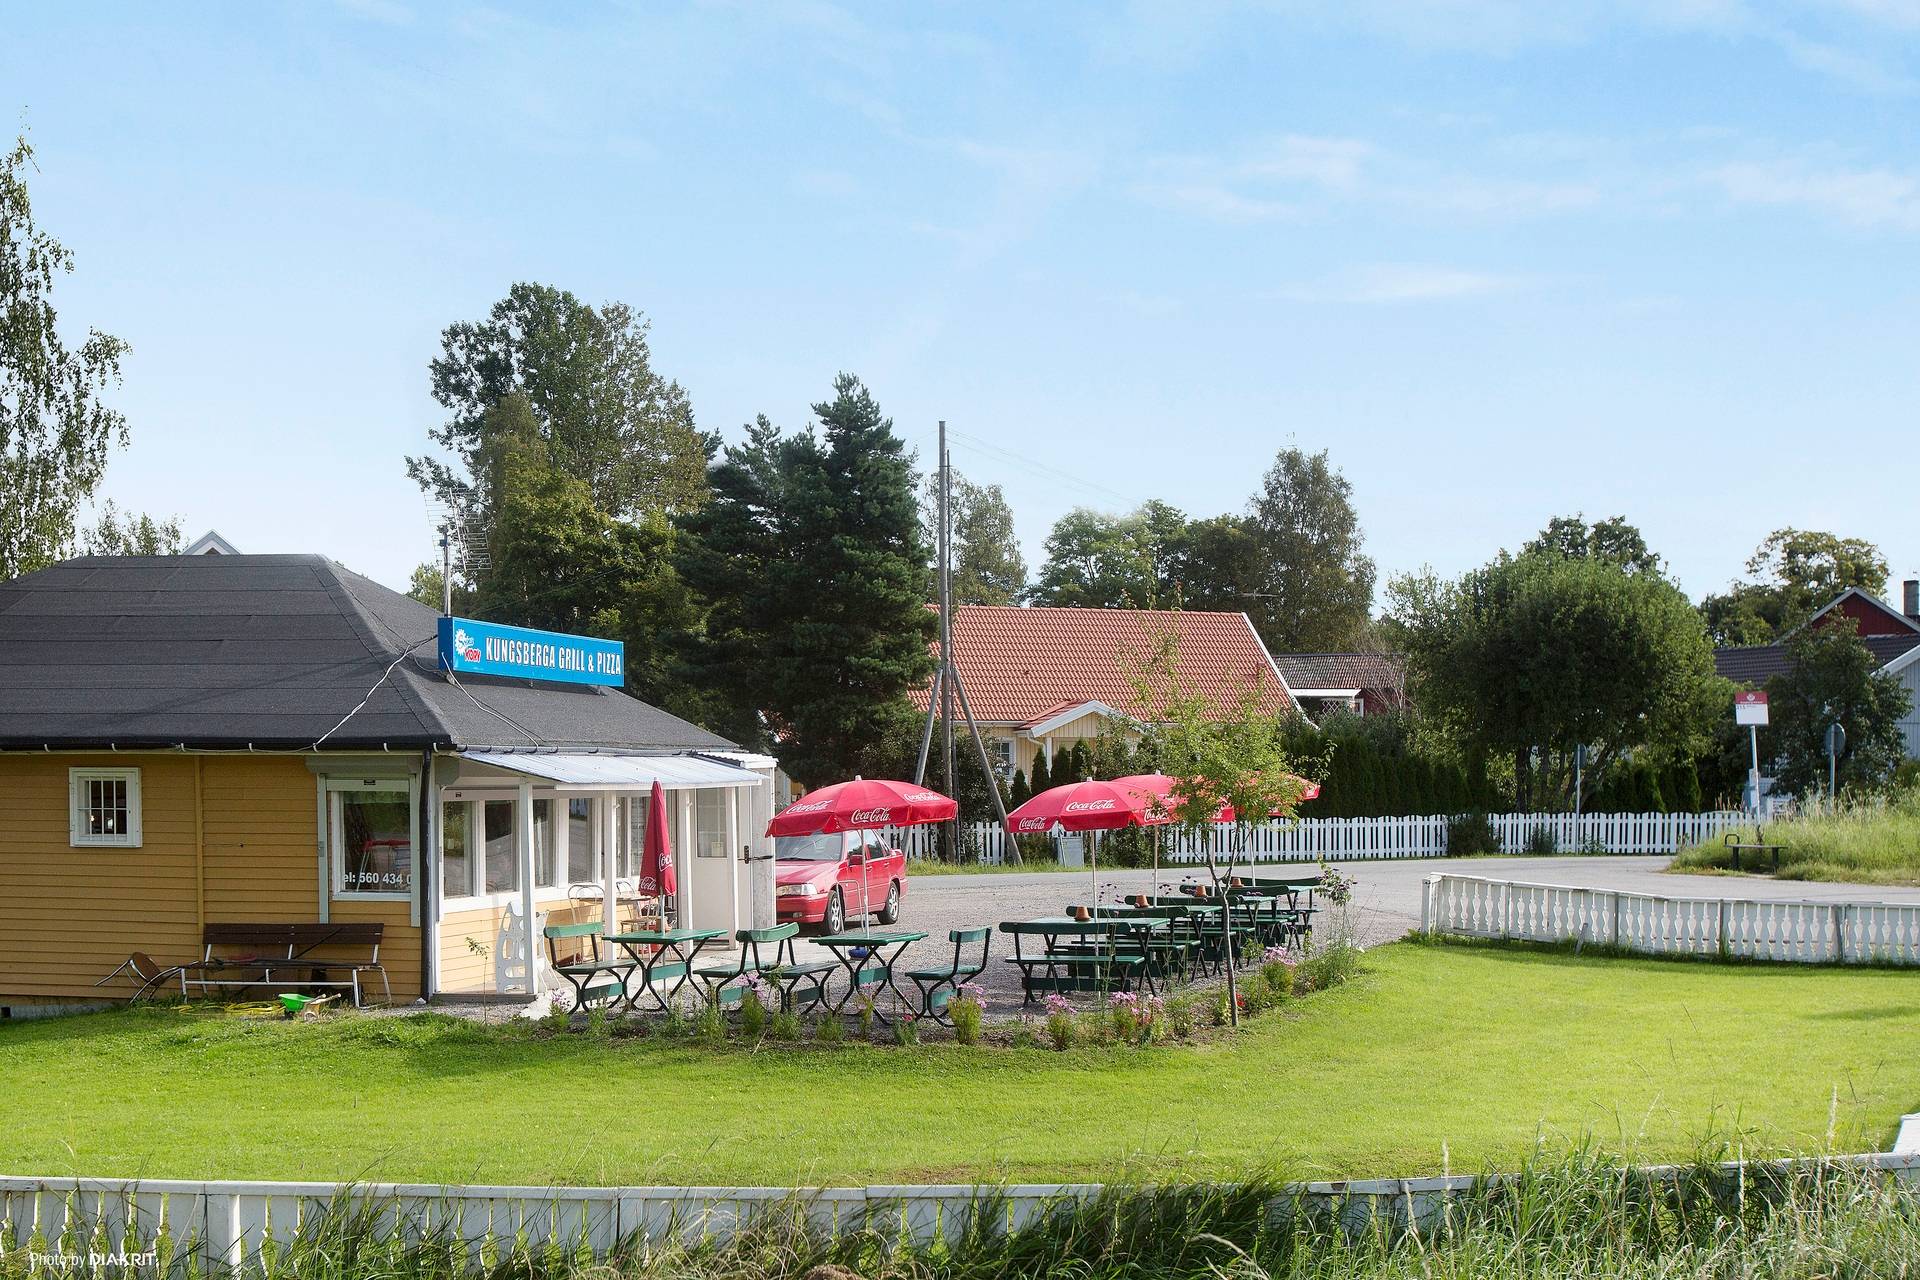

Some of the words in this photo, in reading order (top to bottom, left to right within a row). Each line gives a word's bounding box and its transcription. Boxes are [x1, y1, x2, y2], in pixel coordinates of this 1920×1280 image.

[485, 637, 555, 668] KUNGSBERGA
[559, 647, 585, 672] GRILL
[587, 654, 594, 672] &
[597, 652, 621, 675] PIZZA
[344, 872, 356, 883] el:
[359, 872, 380, 884] 560
[382, 872, 404, 884] 434
